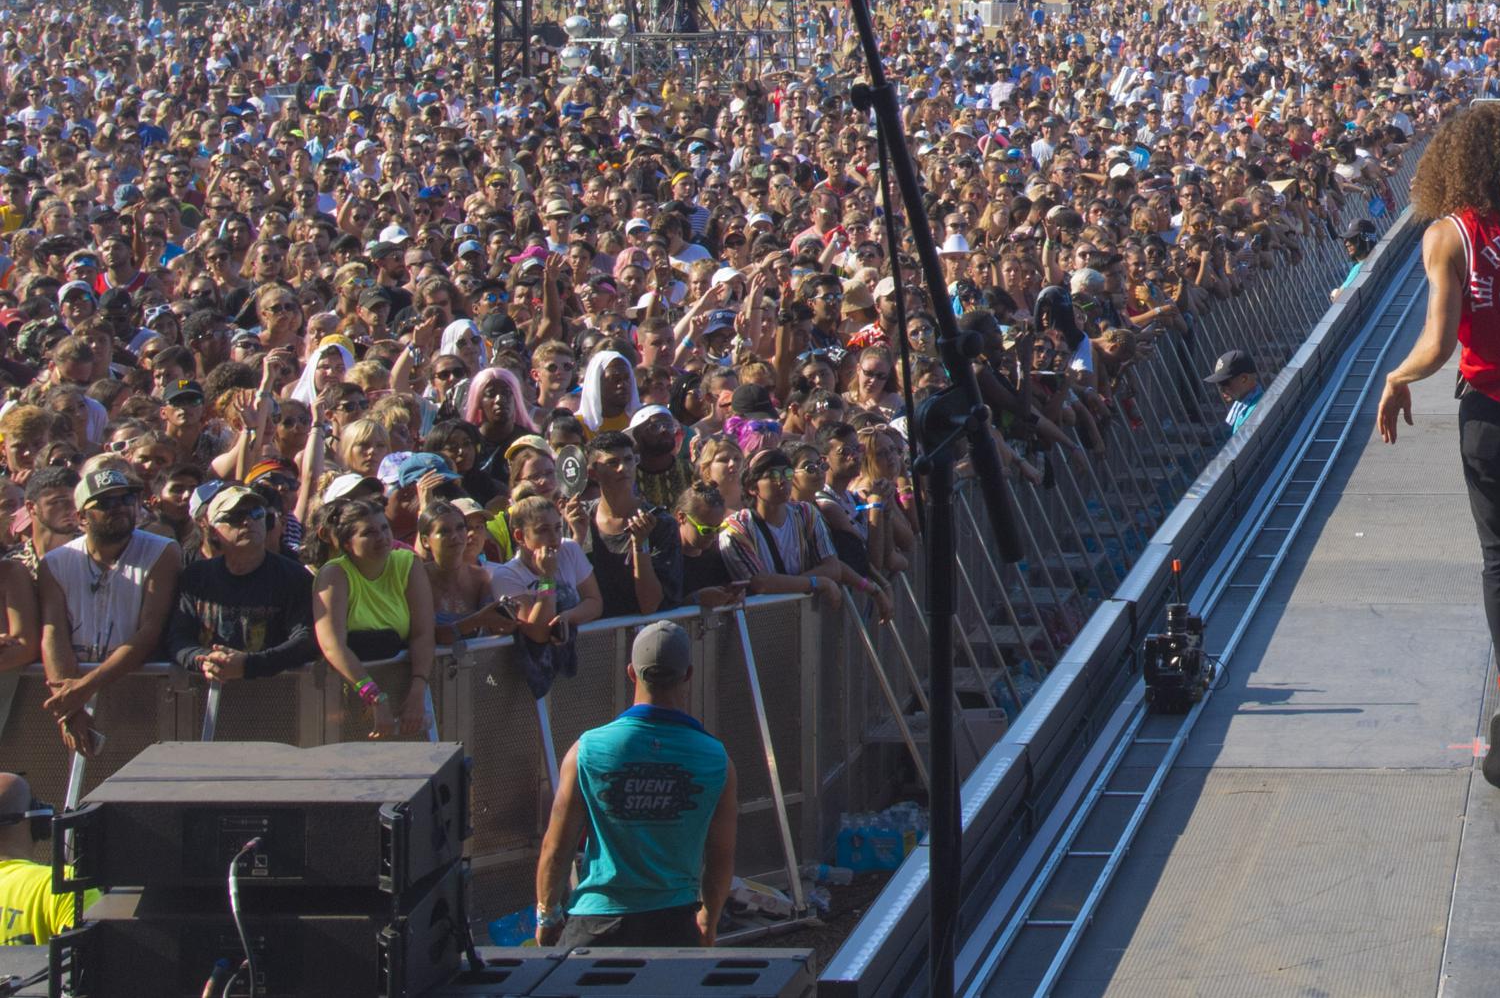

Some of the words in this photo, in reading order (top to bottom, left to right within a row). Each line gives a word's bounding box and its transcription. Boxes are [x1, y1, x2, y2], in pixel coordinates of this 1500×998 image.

[1471, 272, 1494, 313] THE
[623, 778, 677, 794] EVENT
[624, 794, 673, 810] STAFF
